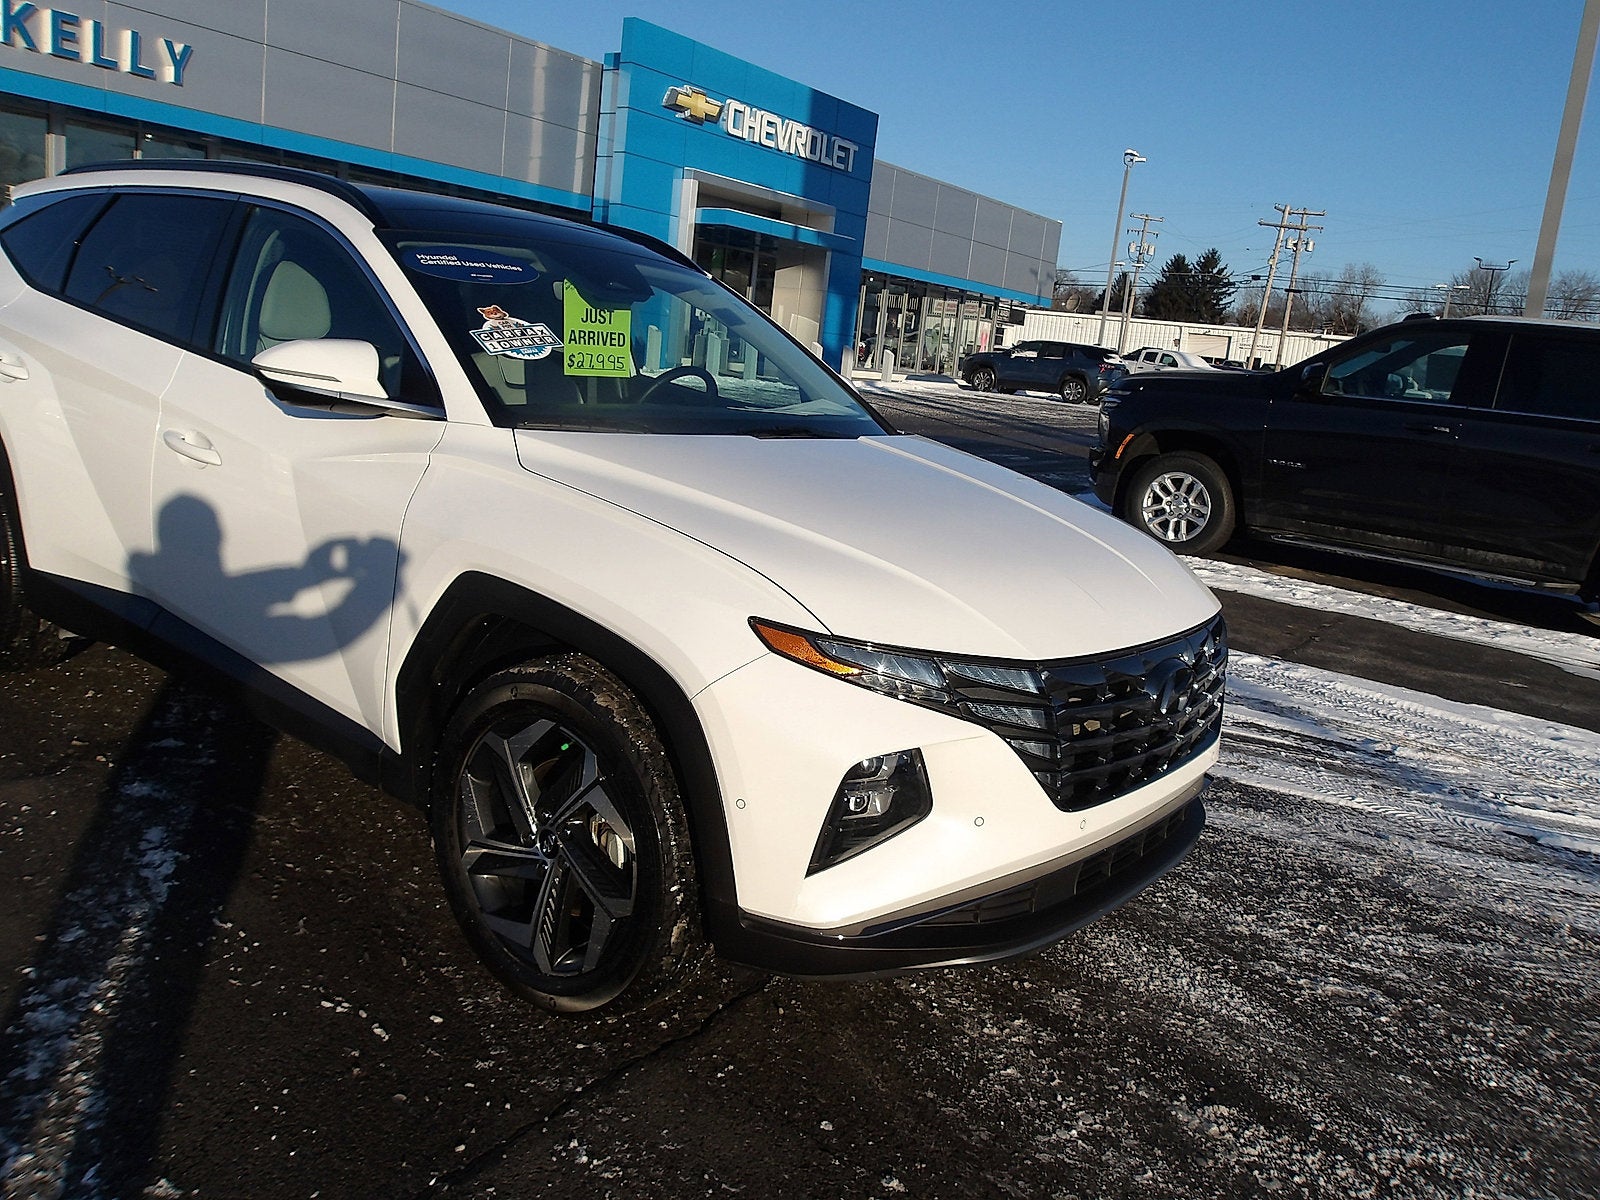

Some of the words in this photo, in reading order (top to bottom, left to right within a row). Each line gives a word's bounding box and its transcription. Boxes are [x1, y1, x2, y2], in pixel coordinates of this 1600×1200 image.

[0, 0, 194, 86] KELLY
[723, 98, 859, 173] CHEVROLET
[415, 253, 458, 261] Hyundai
[484, 263, 523, 272] Vehicles
[581, 308, 615, 325] JUST
[480, 327, 548, 342] CARFAX
[568, 329, 626, 347] ARRIVED
[489, 342, 499, 351] 1
[499, 336, 555, 350] OWNER
[567, 352, 626, 370] $27,995
